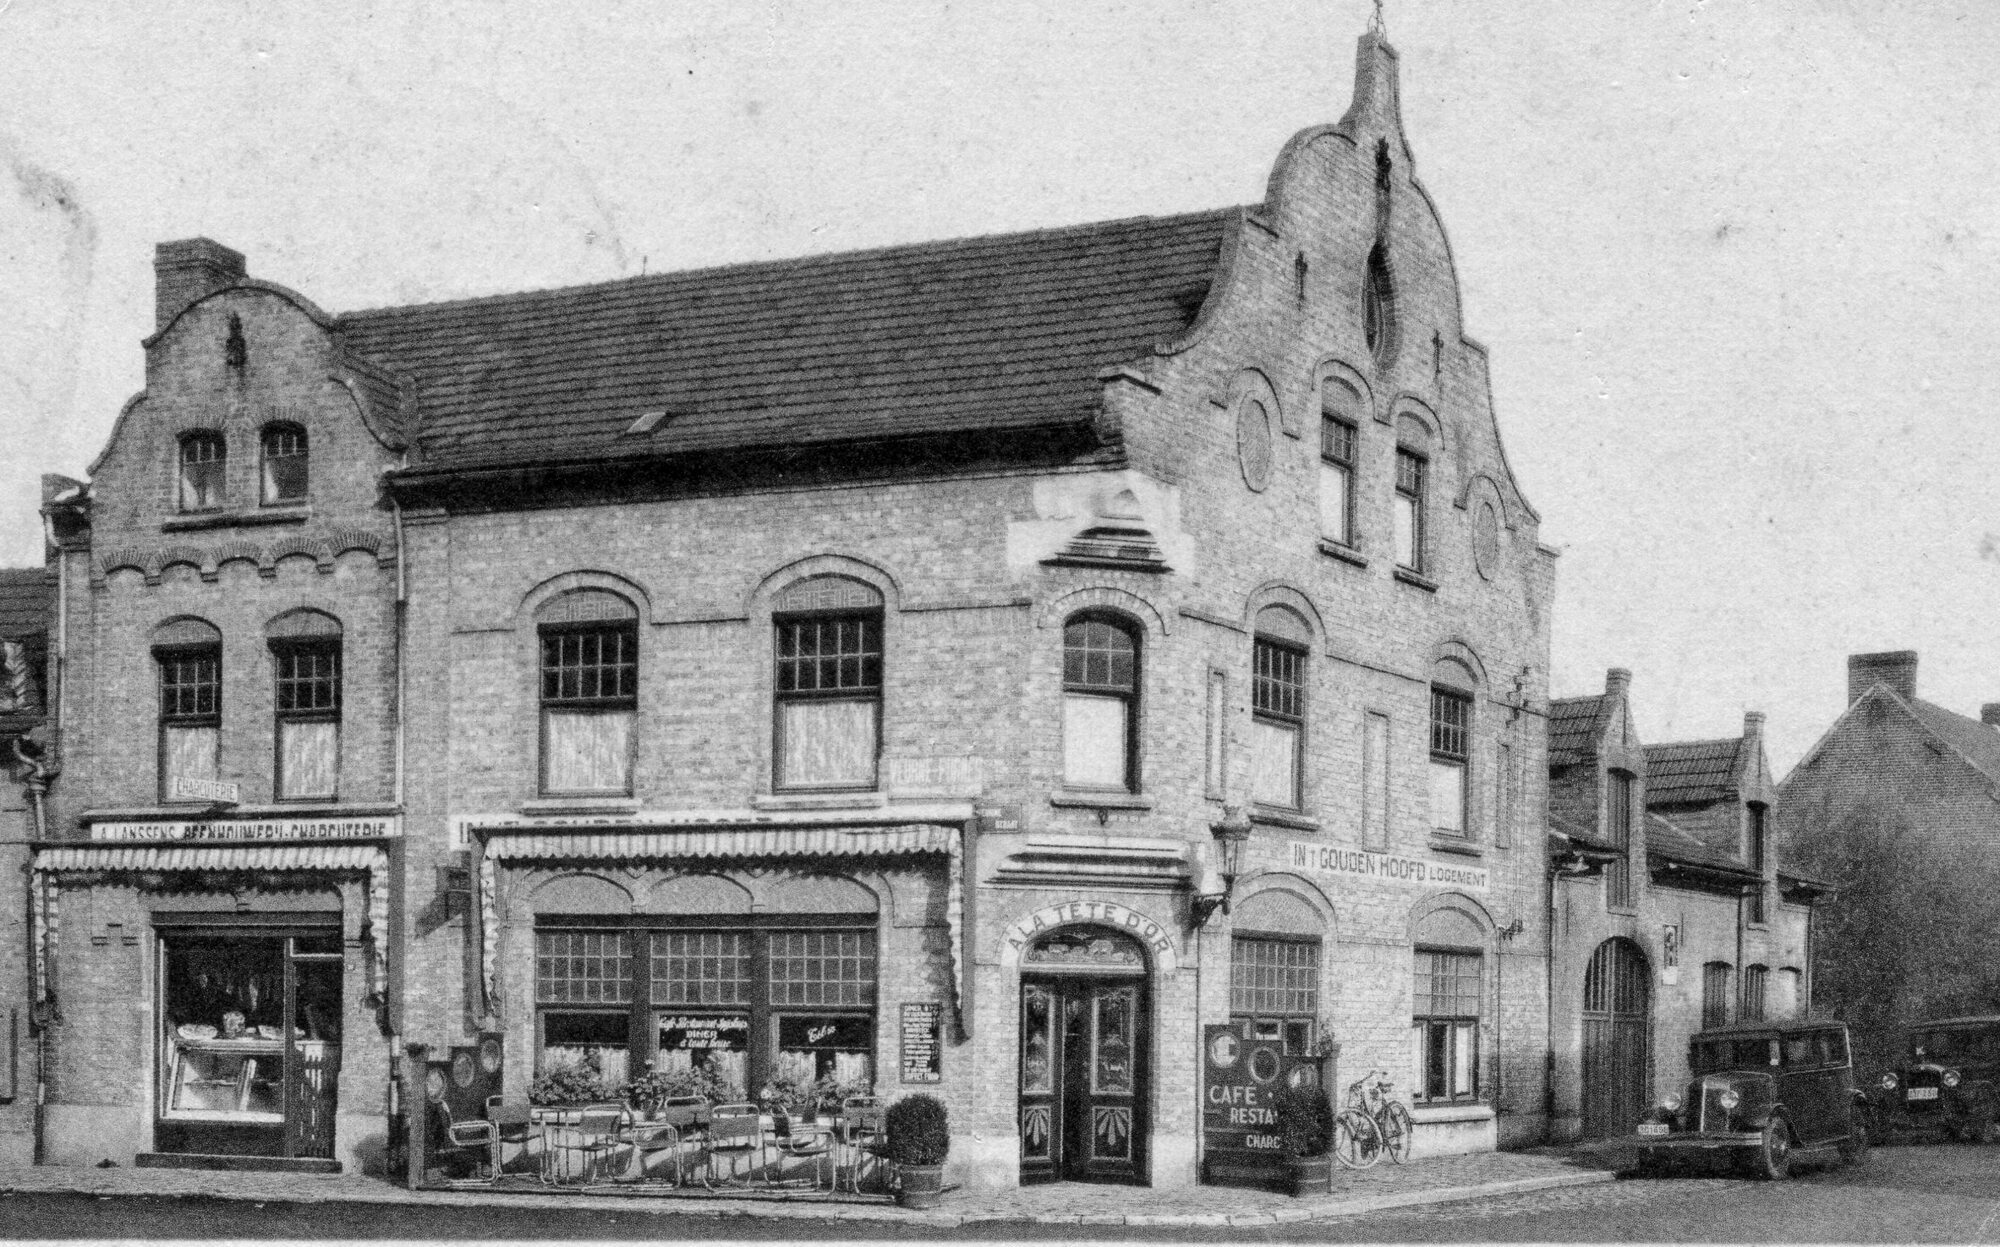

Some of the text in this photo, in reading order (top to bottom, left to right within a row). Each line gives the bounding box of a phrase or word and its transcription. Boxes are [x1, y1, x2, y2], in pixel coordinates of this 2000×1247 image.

[1294, 843, 1306, 866] IN
[1320, 847, 1375, 875] GOUDEN
[1380, 856, 1426, 881] HOOFD
[1429, 866, 1486, 887] LOGEMENT
[1017, 914, 1047, 938] LA
[1209, 1081, 1258, 1105] CAFÉ
